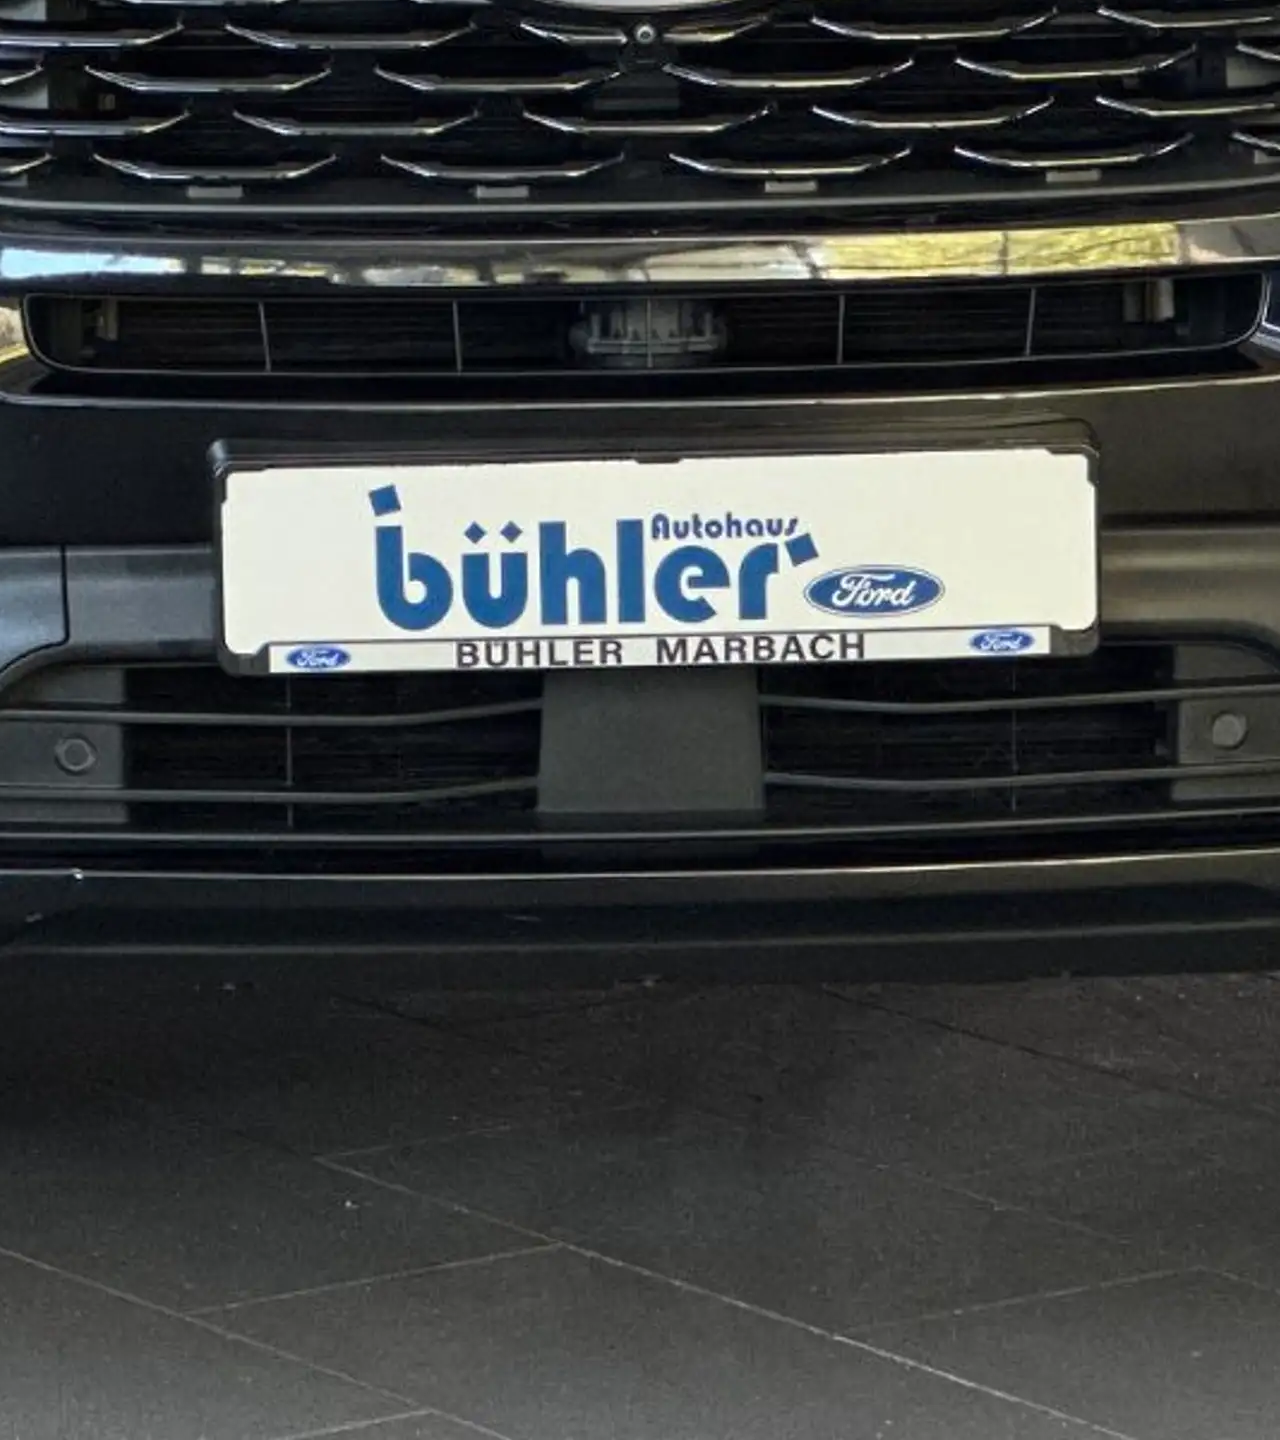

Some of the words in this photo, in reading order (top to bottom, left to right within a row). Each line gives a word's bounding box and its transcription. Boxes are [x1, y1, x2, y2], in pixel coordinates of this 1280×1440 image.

[651, 512, 799, 540] Autohaus
[374, 515, 781, 632] bühler
[831, 572, 918, 607] Ford
[656, 632, 865, 664] MARBACH
[978, 630, 1024, 652] Ford
[295, 648, 342, 668] Ford
